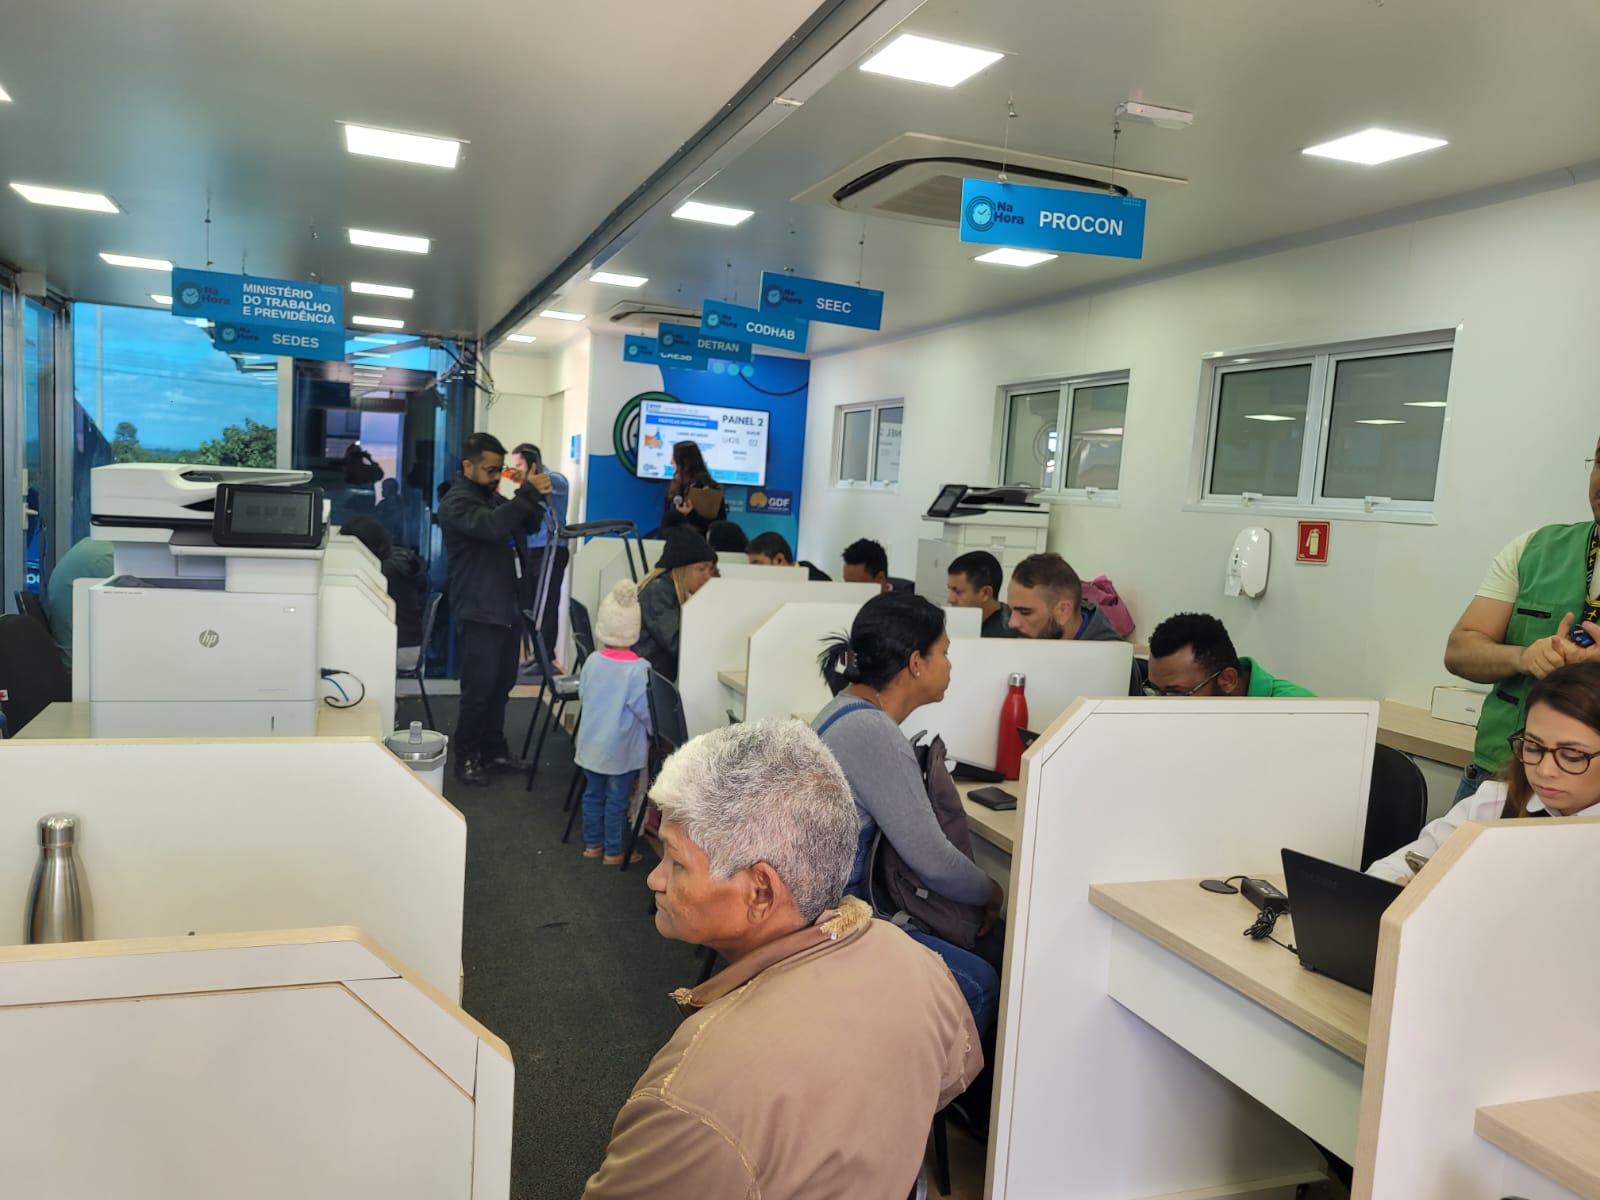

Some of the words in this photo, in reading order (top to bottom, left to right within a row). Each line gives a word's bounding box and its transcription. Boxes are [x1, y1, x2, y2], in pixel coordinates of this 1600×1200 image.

[997, 201, 1014, 212] Na
[994, 212, 1025, 225] Hora
[1039, 210, 1124, 237] PROCON
[242, 283, 313, 300] MINISTÉRIO
[242, 294, 261, 306] DO
[266, 297, 331, 313] TRABALHO
[815, 297, 853, 314] SEEC
[242, 306, 251, 316] E
[254, 307, 336, 325] PREVIDÊNCIA
[745, 321, 796, 341] CODHAB
[272, 333, 320, 349] SEDES
[697, 338, 740, 353] DETRAN
[722, 415, 755, 427] PAINEL
[757, 418, 764, 427] 2
[768, 497, 790, 508] GDF
[201, 630, 218, 648] hp
